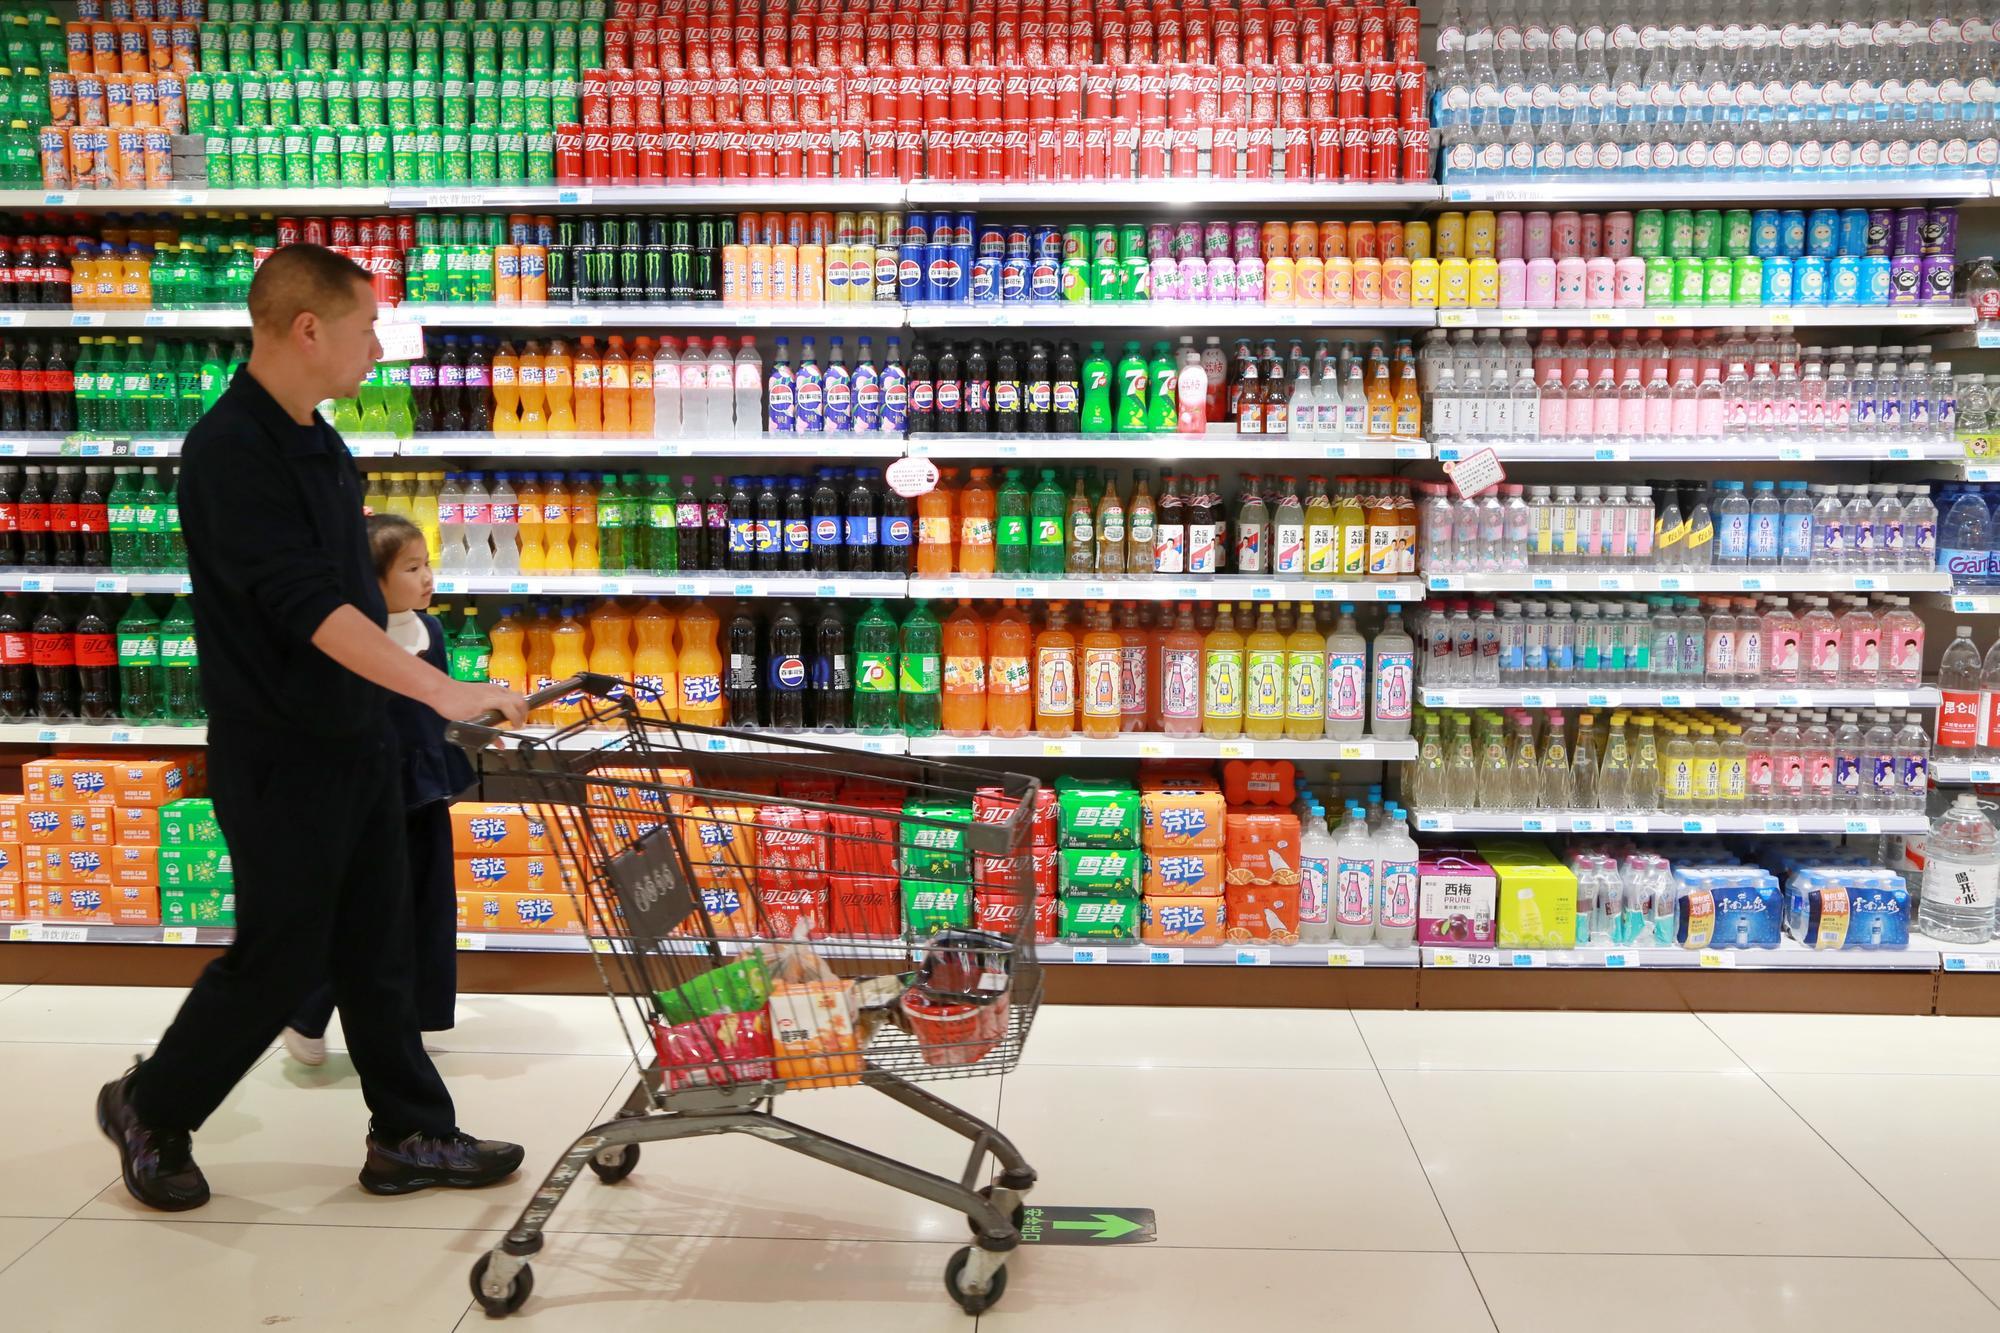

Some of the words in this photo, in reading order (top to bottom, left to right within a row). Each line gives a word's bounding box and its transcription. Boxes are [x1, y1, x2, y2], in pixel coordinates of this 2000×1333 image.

[120, 640, 159, 656] 雪碧
[162, 640, 197, 656] 雪碧
[684, 676, 721, 701] 芬达
[1944, 701, 1977, 715] 昆仑山
[72, 772, 105, 794] 芬达
[28, 811, 60, 832] 芬达
[1075, 806, 1127, 828] 雪碧
[1160, 808, 1205, 835] 芬达
[470, 818, 507, 842] 芬达
[764, 830, 815, 846] 可口可乐
[914, 829, 960, 848] 雪碧
[69, 852, 101, 872] 芬达
[470, 857, 507, 881] 芬达
[1075, 856, 1127, 877] 雪碧
[1160, 856, 1204, 883] 芬达
[763, 889, 815, 905] 可口可乐
[1445, 883, 1472, 896] 西梅
[1955, 871, 1976, 904] 喝开水
[71, 890, 103, 911] 芬达
[911, 892, 959, 911] 雪碧
[1444, 896, 1471, 904] PRUNE
[516, 899, 554, 923] 芬达
[1074, 903, 1125, 923] 雪碧
[1160, 906, 1205, 932] 芬达
[1477, 955, 1491, 964] 29
[1022, 1208, 1044, 1242] 安全出口
